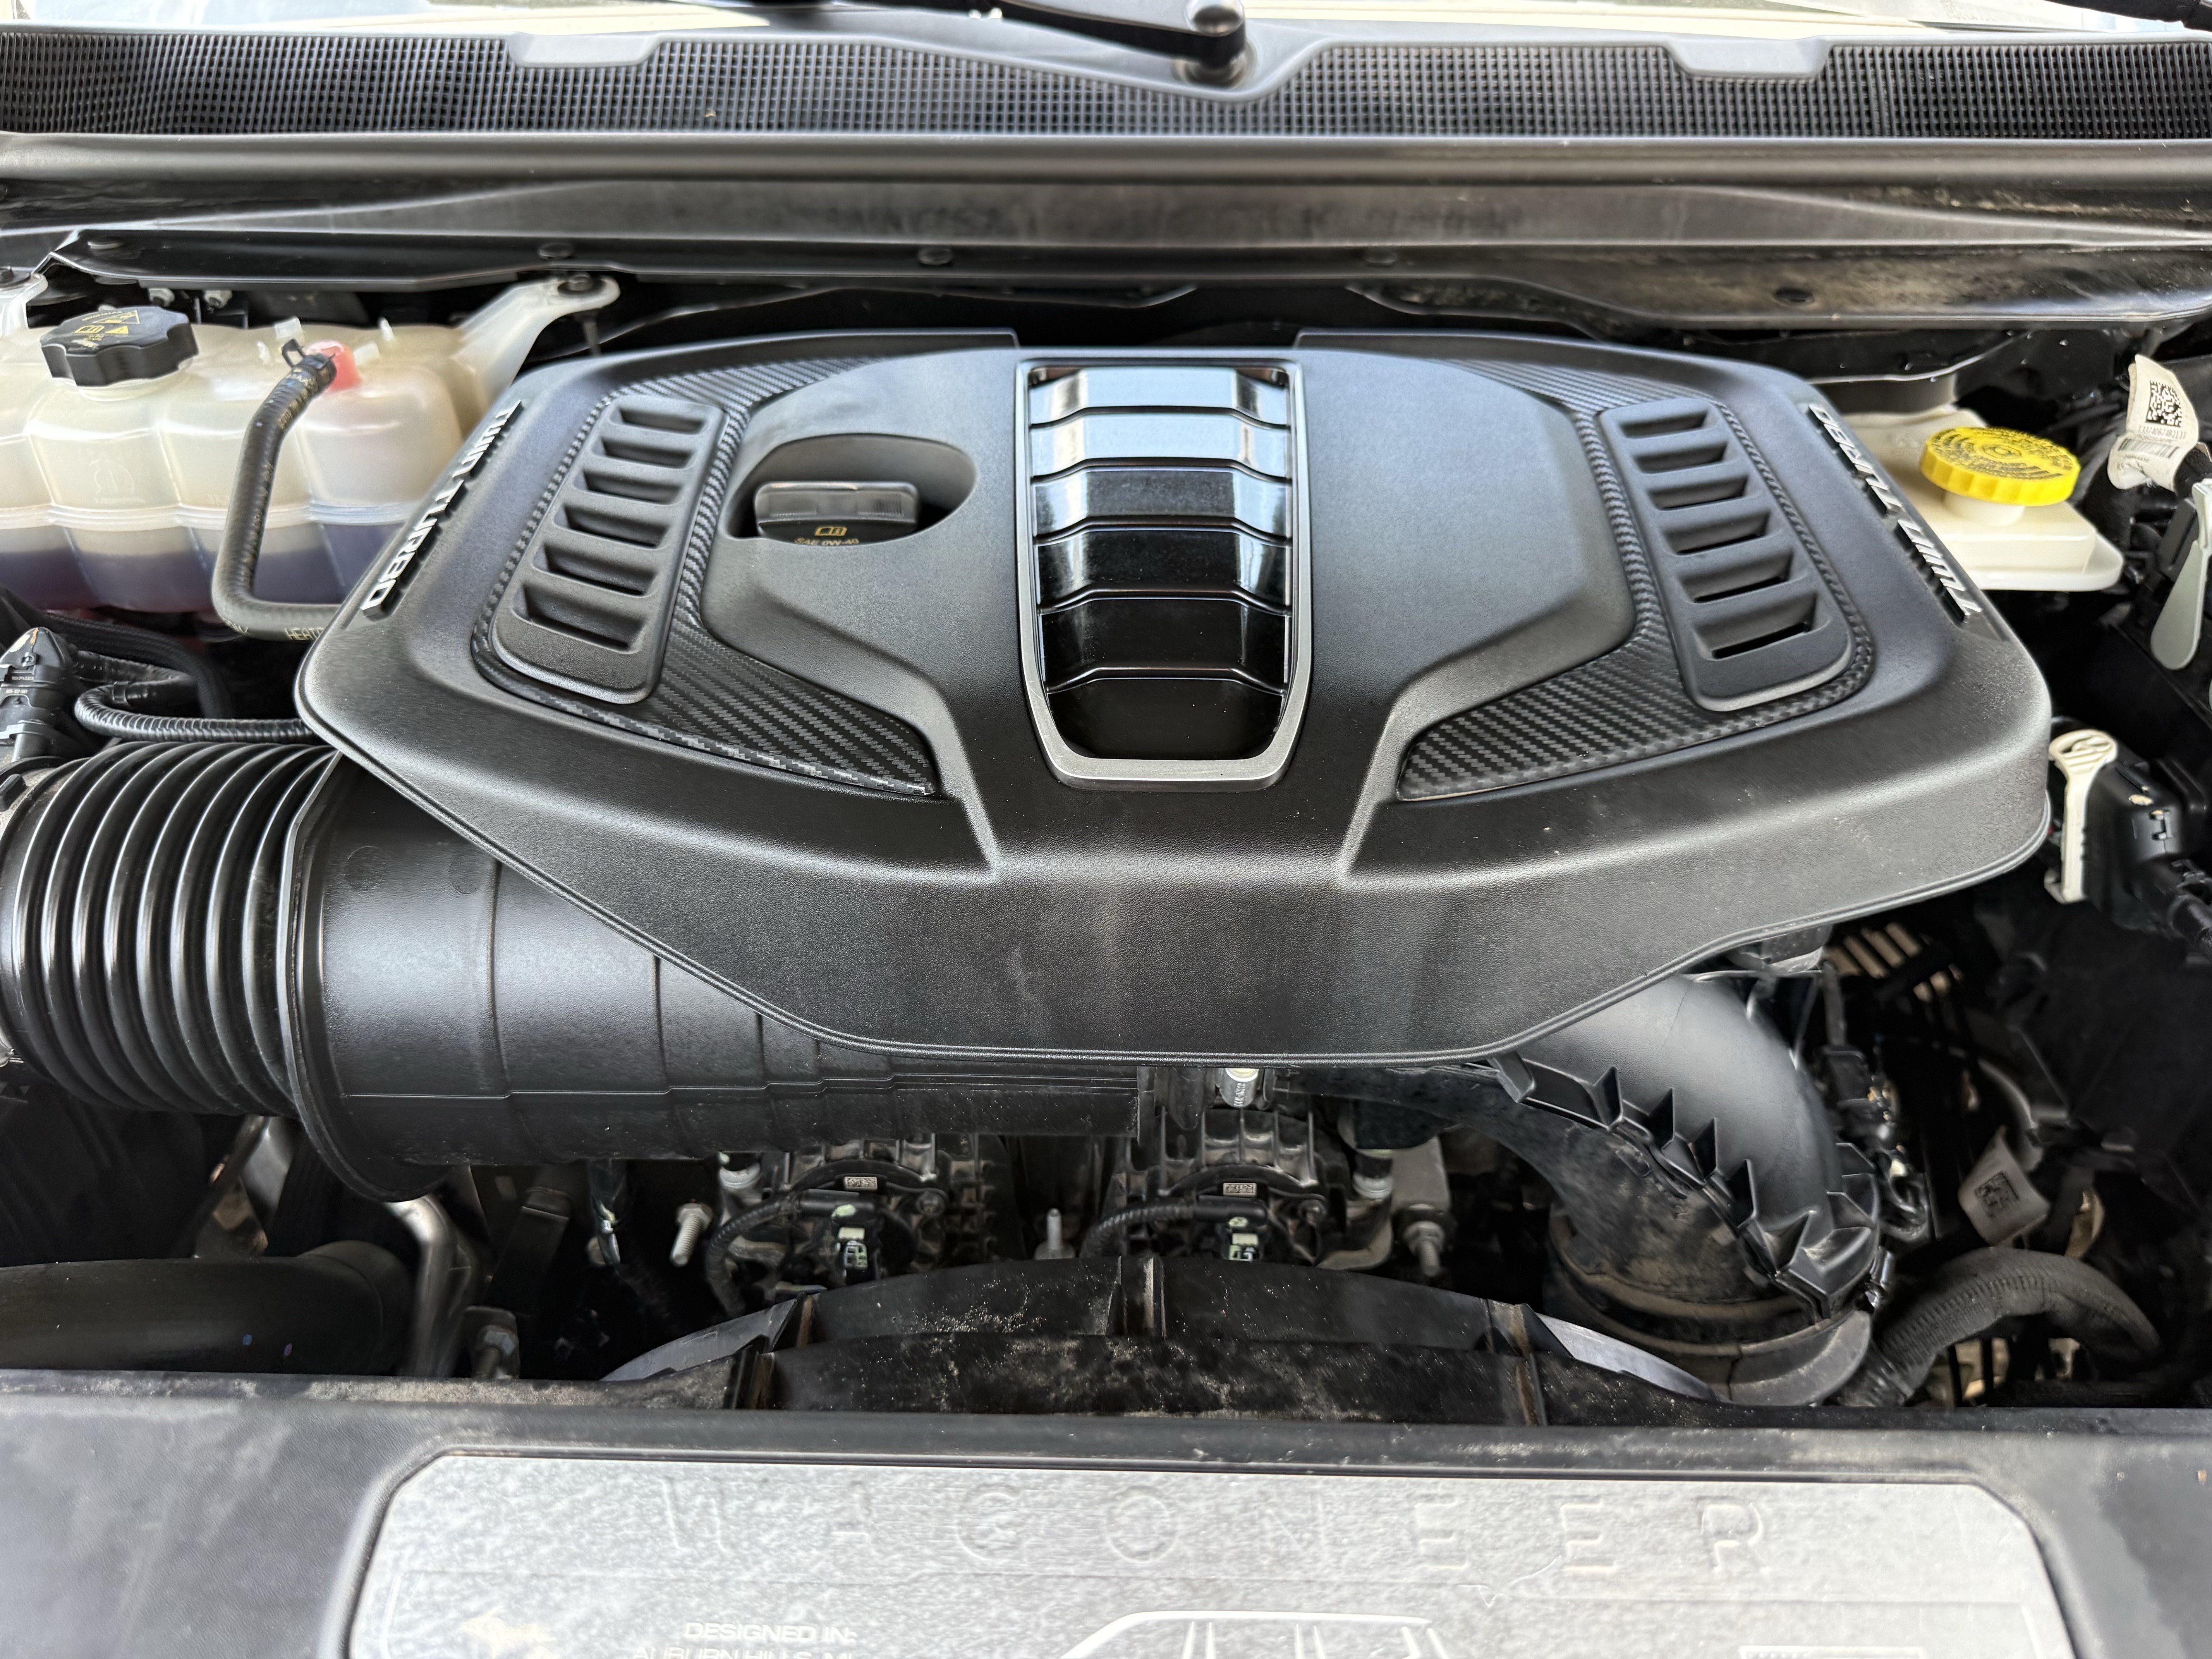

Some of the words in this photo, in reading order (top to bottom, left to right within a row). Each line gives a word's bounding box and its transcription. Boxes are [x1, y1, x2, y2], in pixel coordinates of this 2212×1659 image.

[1809, 405, 1903, 510] TURBO
[360, 479, 464, 610] TURBO
[683, 1622, 816, 1642] DESIGNED
